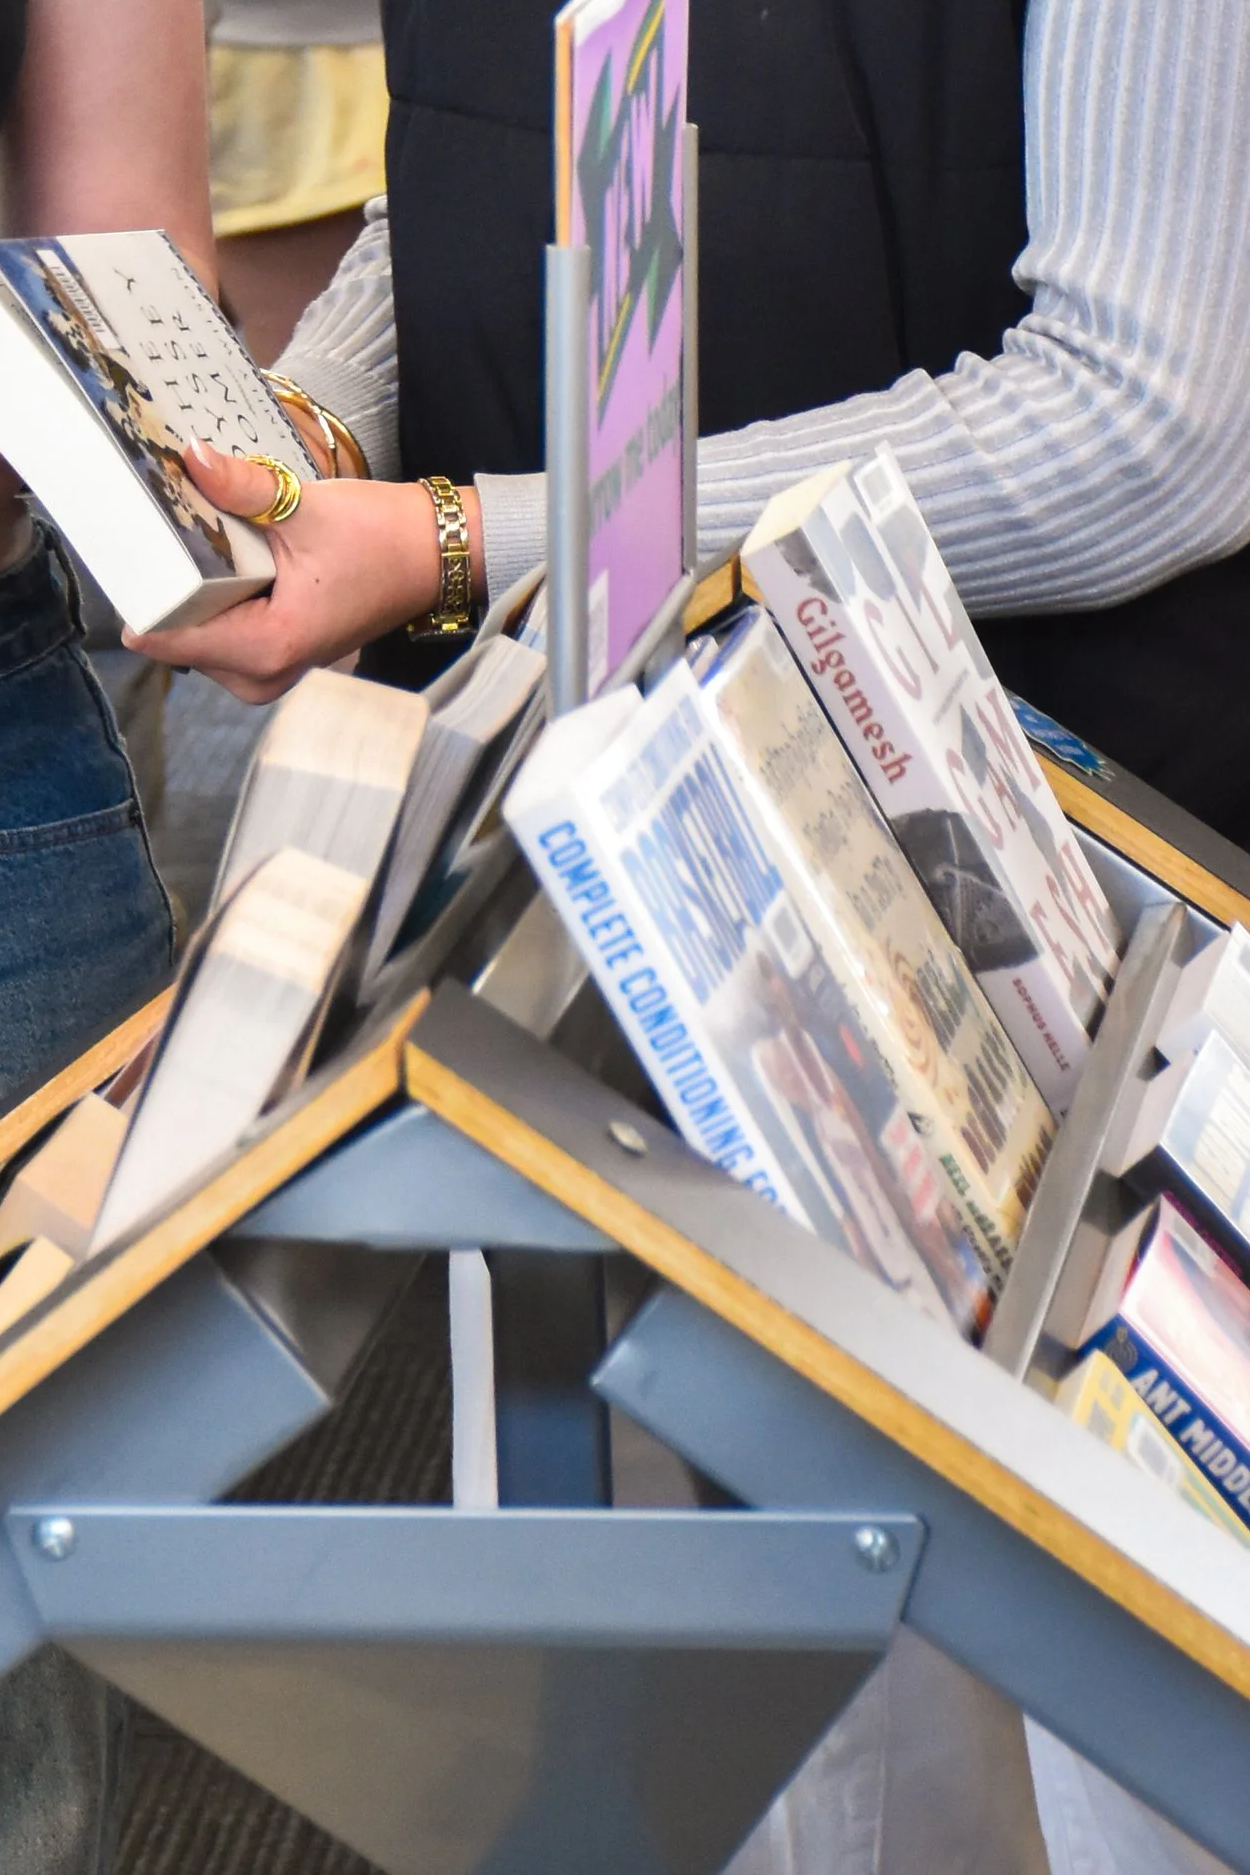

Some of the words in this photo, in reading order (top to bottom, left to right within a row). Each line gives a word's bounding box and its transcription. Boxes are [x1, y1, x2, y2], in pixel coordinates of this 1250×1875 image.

[171, 310, 258, 443] OMER
[795, 597, 912, 785] Gilgamesh
[538, 820, 644, 970] COMPLETE
[619, 966, 754, 1170] CONDITIONING
[1012, 977, 1047, 1032] SOPHUS
[1042, 1026, 1070, 1072] HELLE
[1130, 1368, 1192, 1425] ANT
